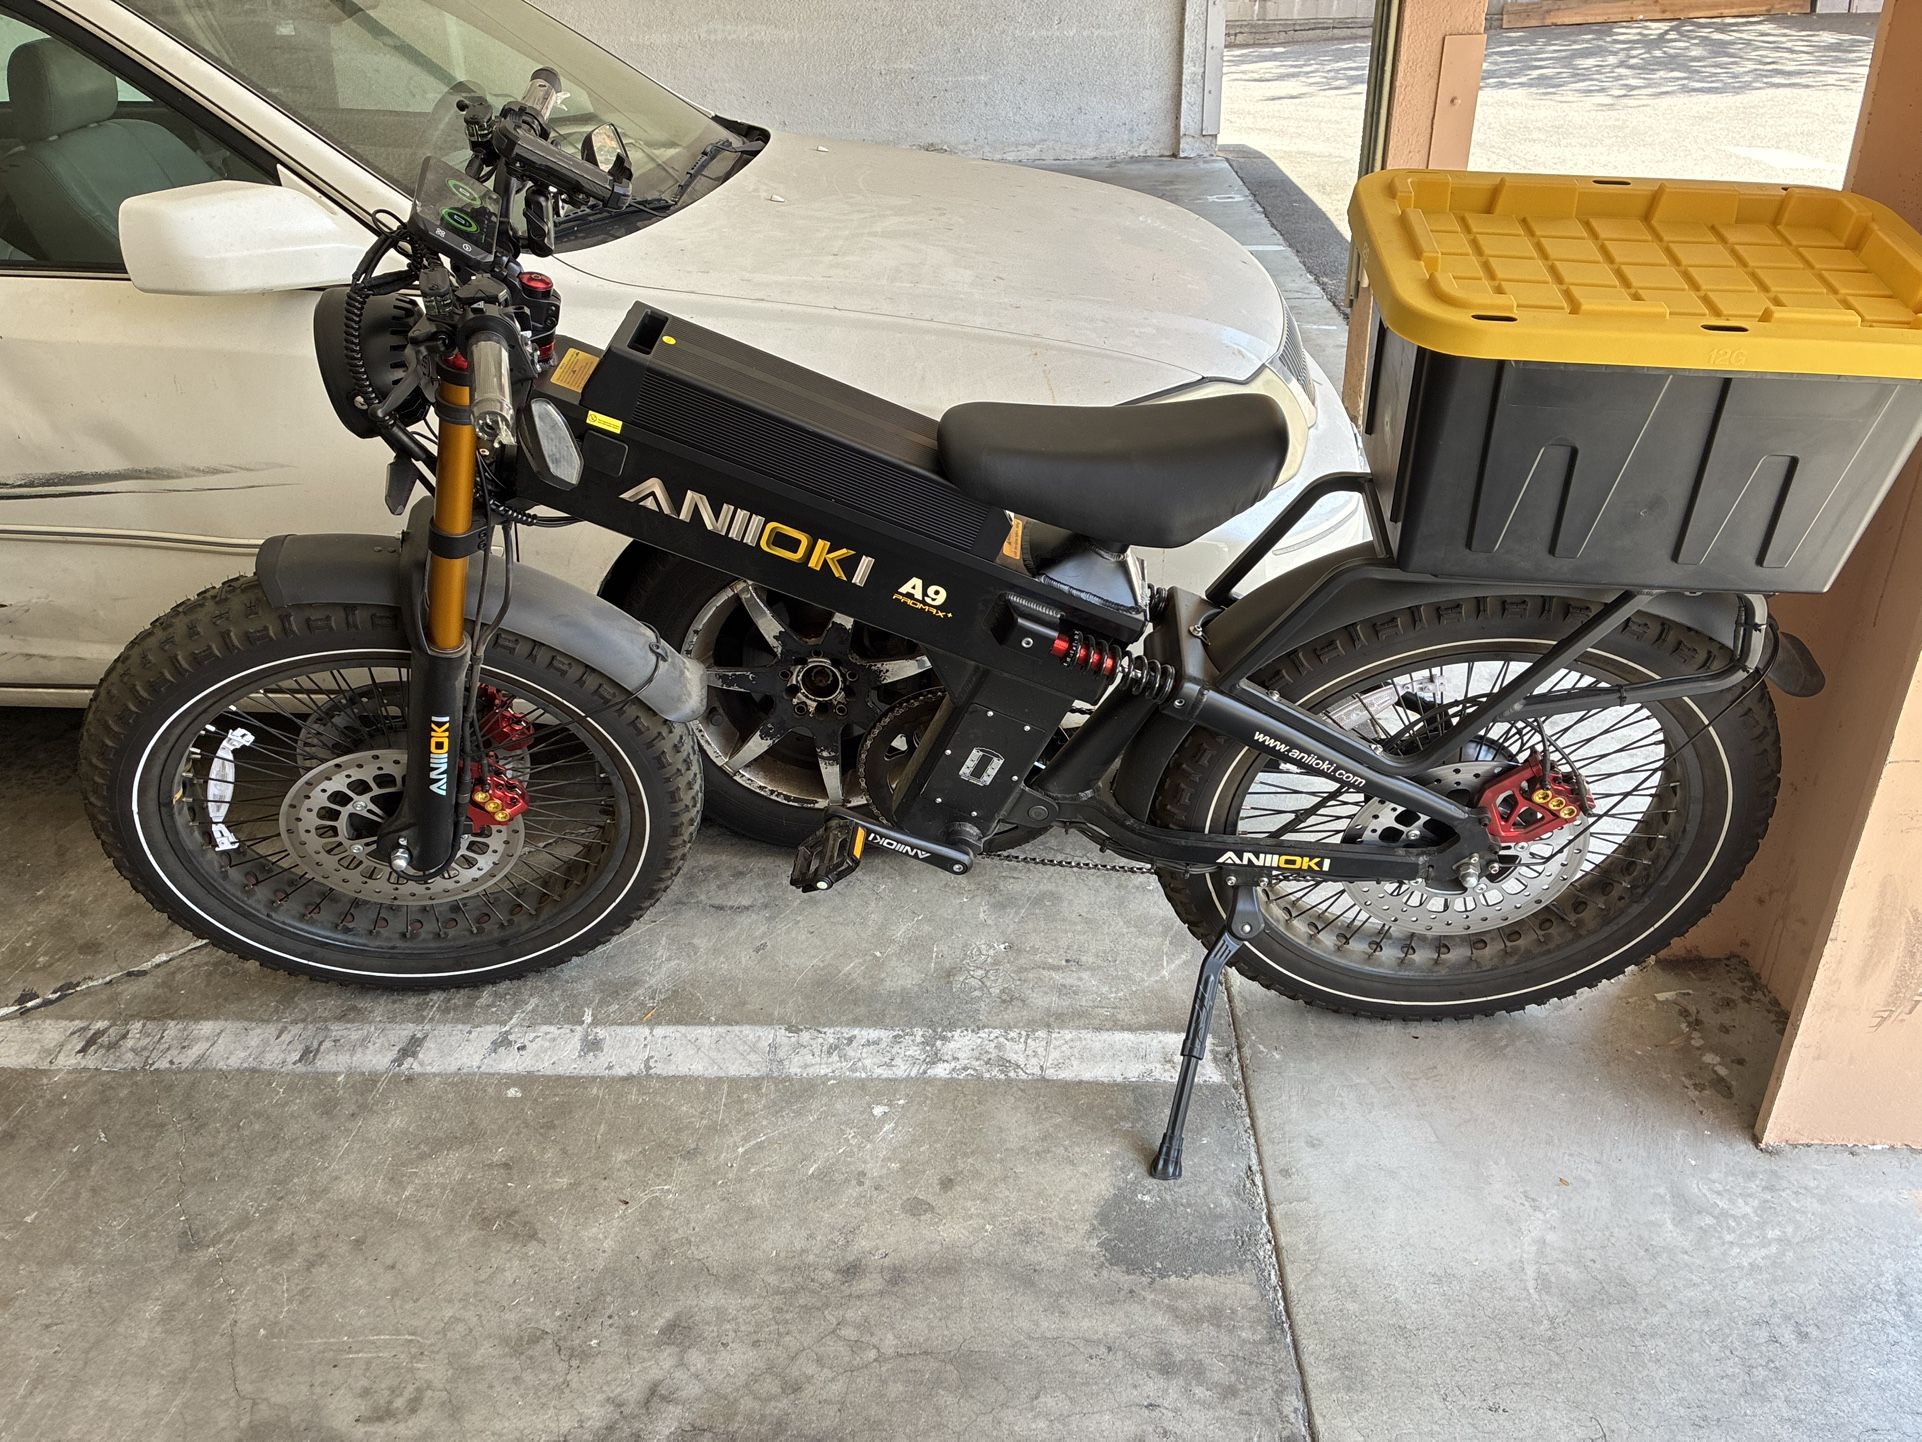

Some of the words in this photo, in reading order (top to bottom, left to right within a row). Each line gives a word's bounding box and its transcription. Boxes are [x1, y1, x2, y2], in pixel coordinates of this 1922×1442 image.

[618, 477, 875, 588] ANIIOKI
[898, 577, 947, 606] A9
[429, 716, 450, 796] ANIIOKI
[1253, 731, 1366, 787] www.aniioki.com
[868, 832, 932, 859] ANIIOKI
[1215, 850, 1331, 872] ANIIOKI
